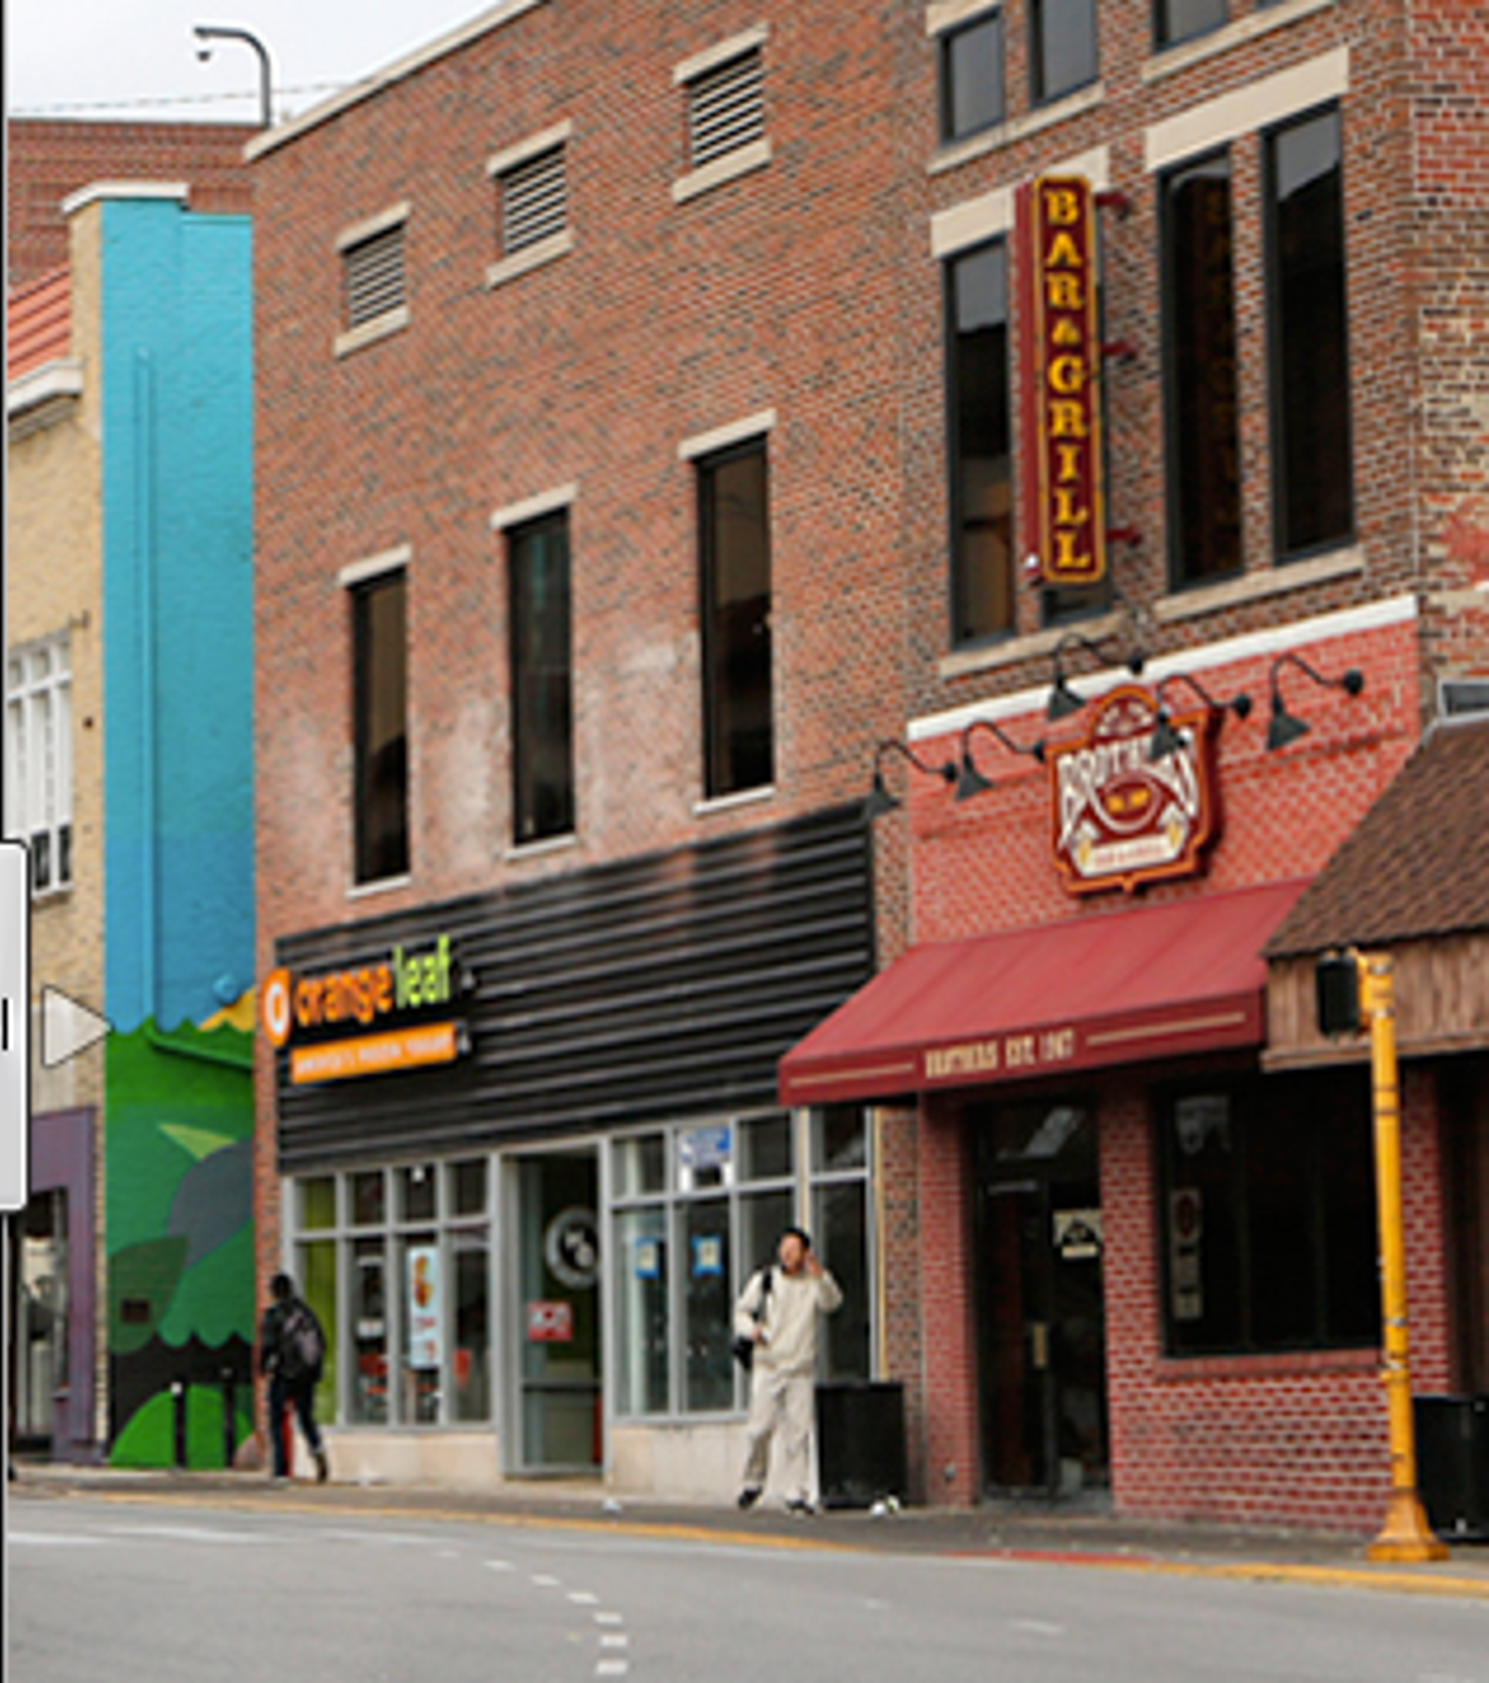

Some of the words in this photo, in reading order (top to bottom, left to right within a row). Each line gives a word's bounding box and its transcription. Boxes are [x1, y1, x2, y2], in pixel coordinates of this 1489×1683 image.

[1044, 188, 1084, 310] BAR
[1052, 317, 1079, 345] &
[1048, 355, 1090, 570] GRILL
[296, 964, 393, 1028] orange
[393, 933, 451, 1009] leaf
